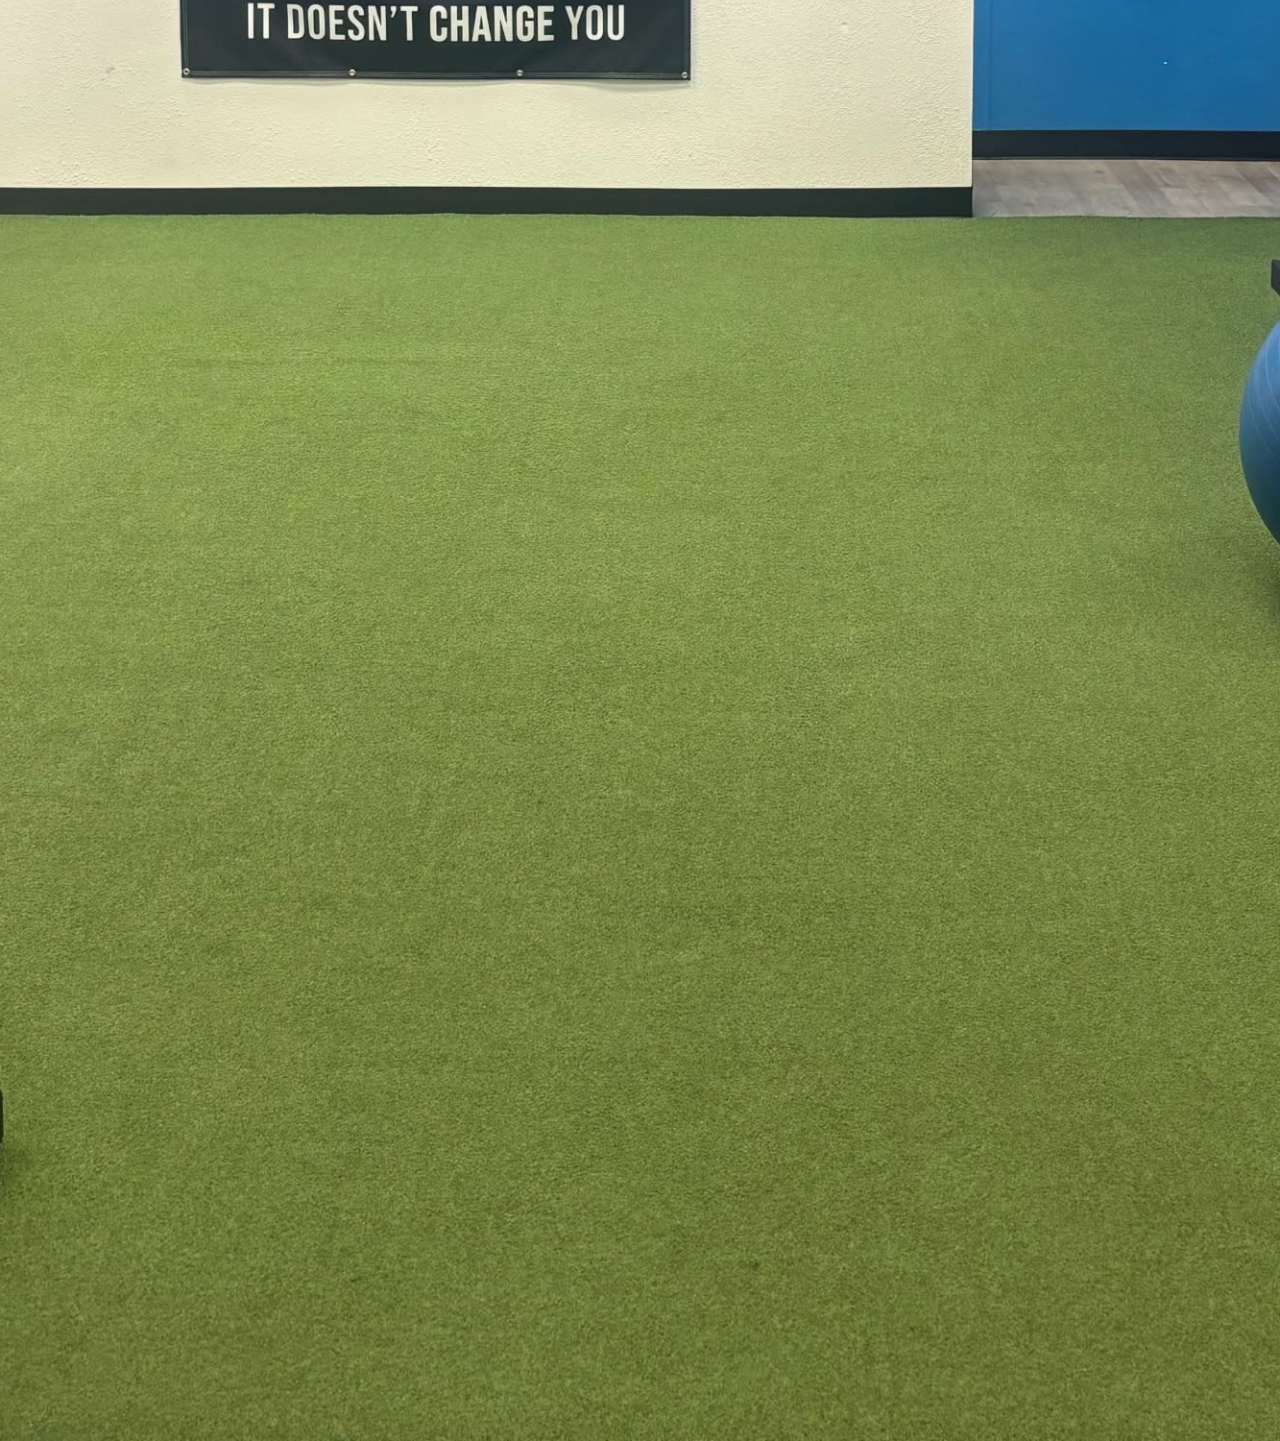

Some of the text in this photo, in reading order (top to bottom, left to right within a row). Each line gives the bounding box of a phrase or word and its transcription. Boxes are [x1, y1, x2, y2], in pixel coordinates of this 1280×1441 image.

[247, 3, 625, 42] IT DOESN'T CHANGE YOU
